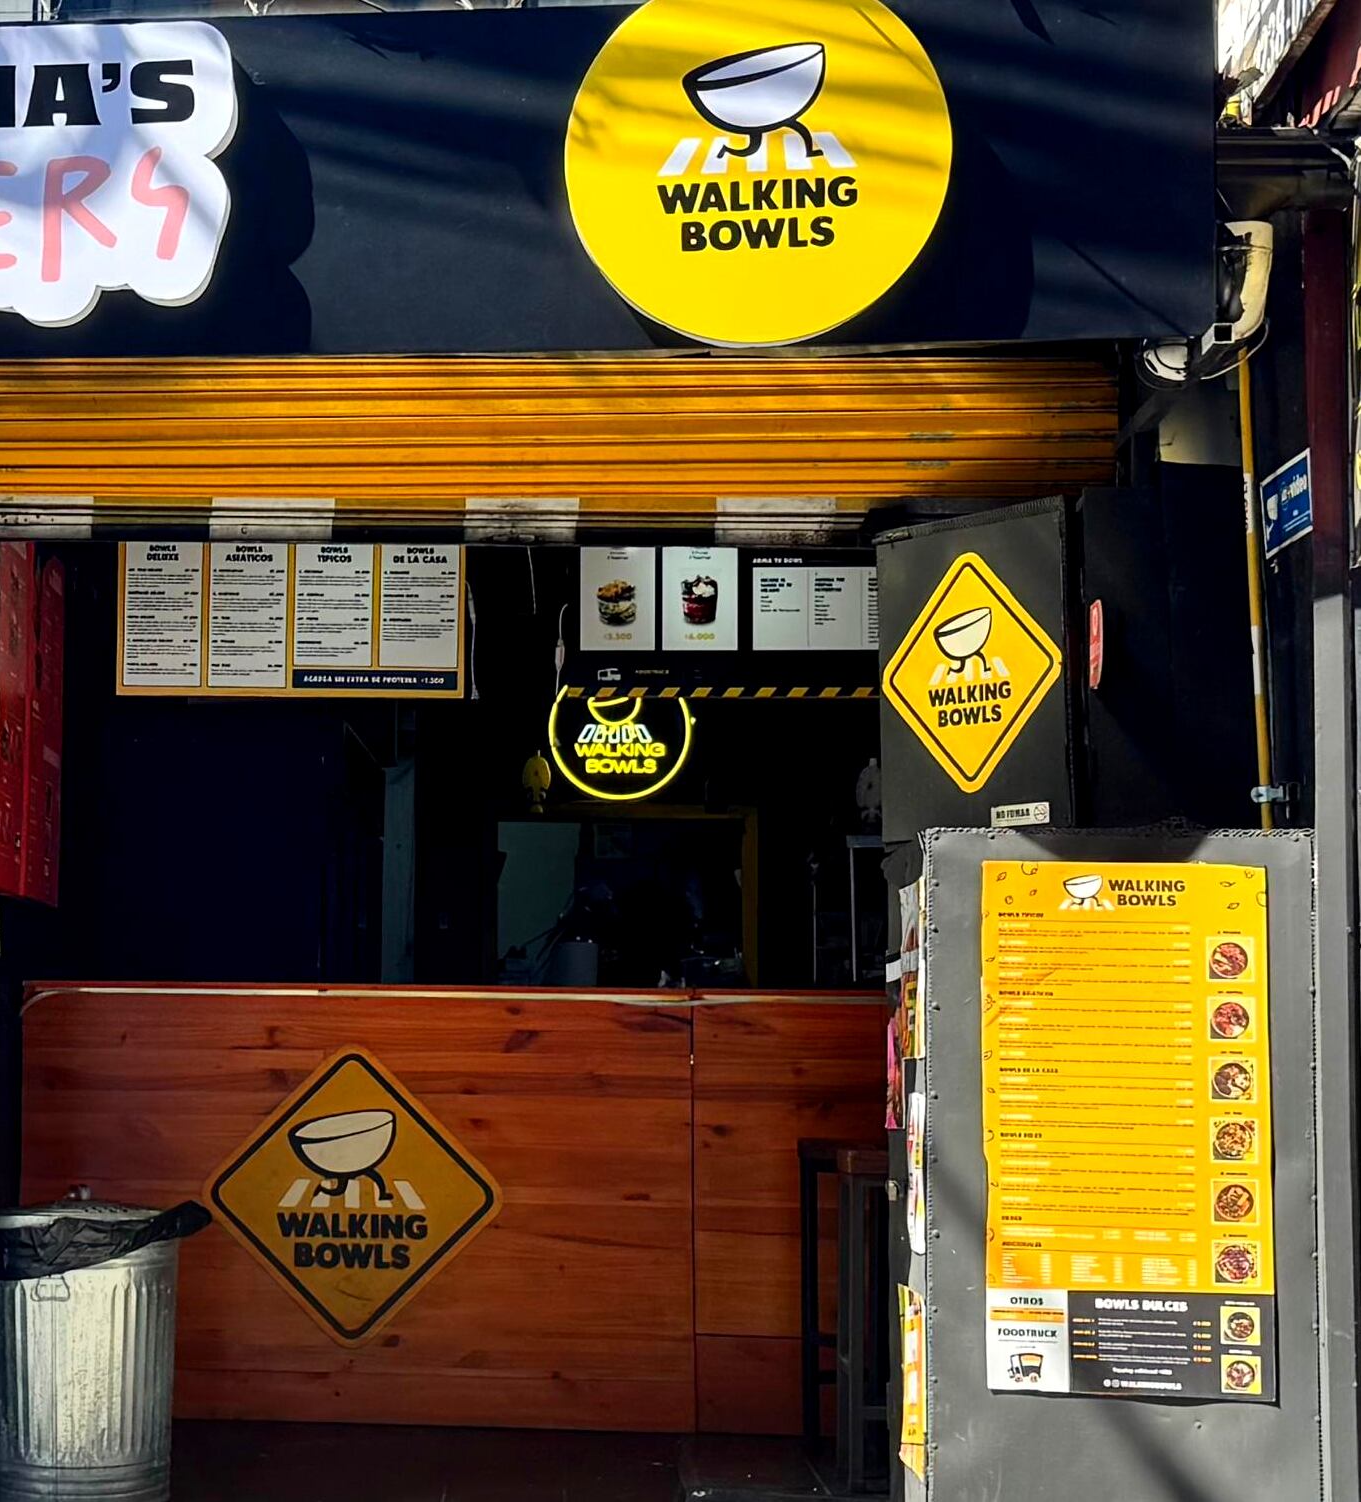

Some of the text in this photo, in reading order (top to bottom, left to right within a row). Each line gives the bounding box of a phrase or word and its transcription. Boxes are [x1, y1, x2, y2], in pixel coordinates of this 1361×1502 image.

[657, 176, 859, 214] WALKING
[681, 216, 835, 252] BOWLS
[928, 681, 1012, 708] WALKING
[937, 705, 1002, 728] BOWLS
[574, 743, 666, 757] WALKING
[585, 758, 658, 774] BOWLS
[1108, 879, 1186, 893] WALKING
[1117, 894, 1177, 907] BOWLS
[276, 1212, 428, 1240] WALKING
[293, 1242, 411, 1269] BOWLS
[1010, 1297, 1044, 1306] OTROS
[1095, 1298, 1188, 1312] BOWLS DULCES
[998, 1328, 1058, 1338] FOODTRUCK
